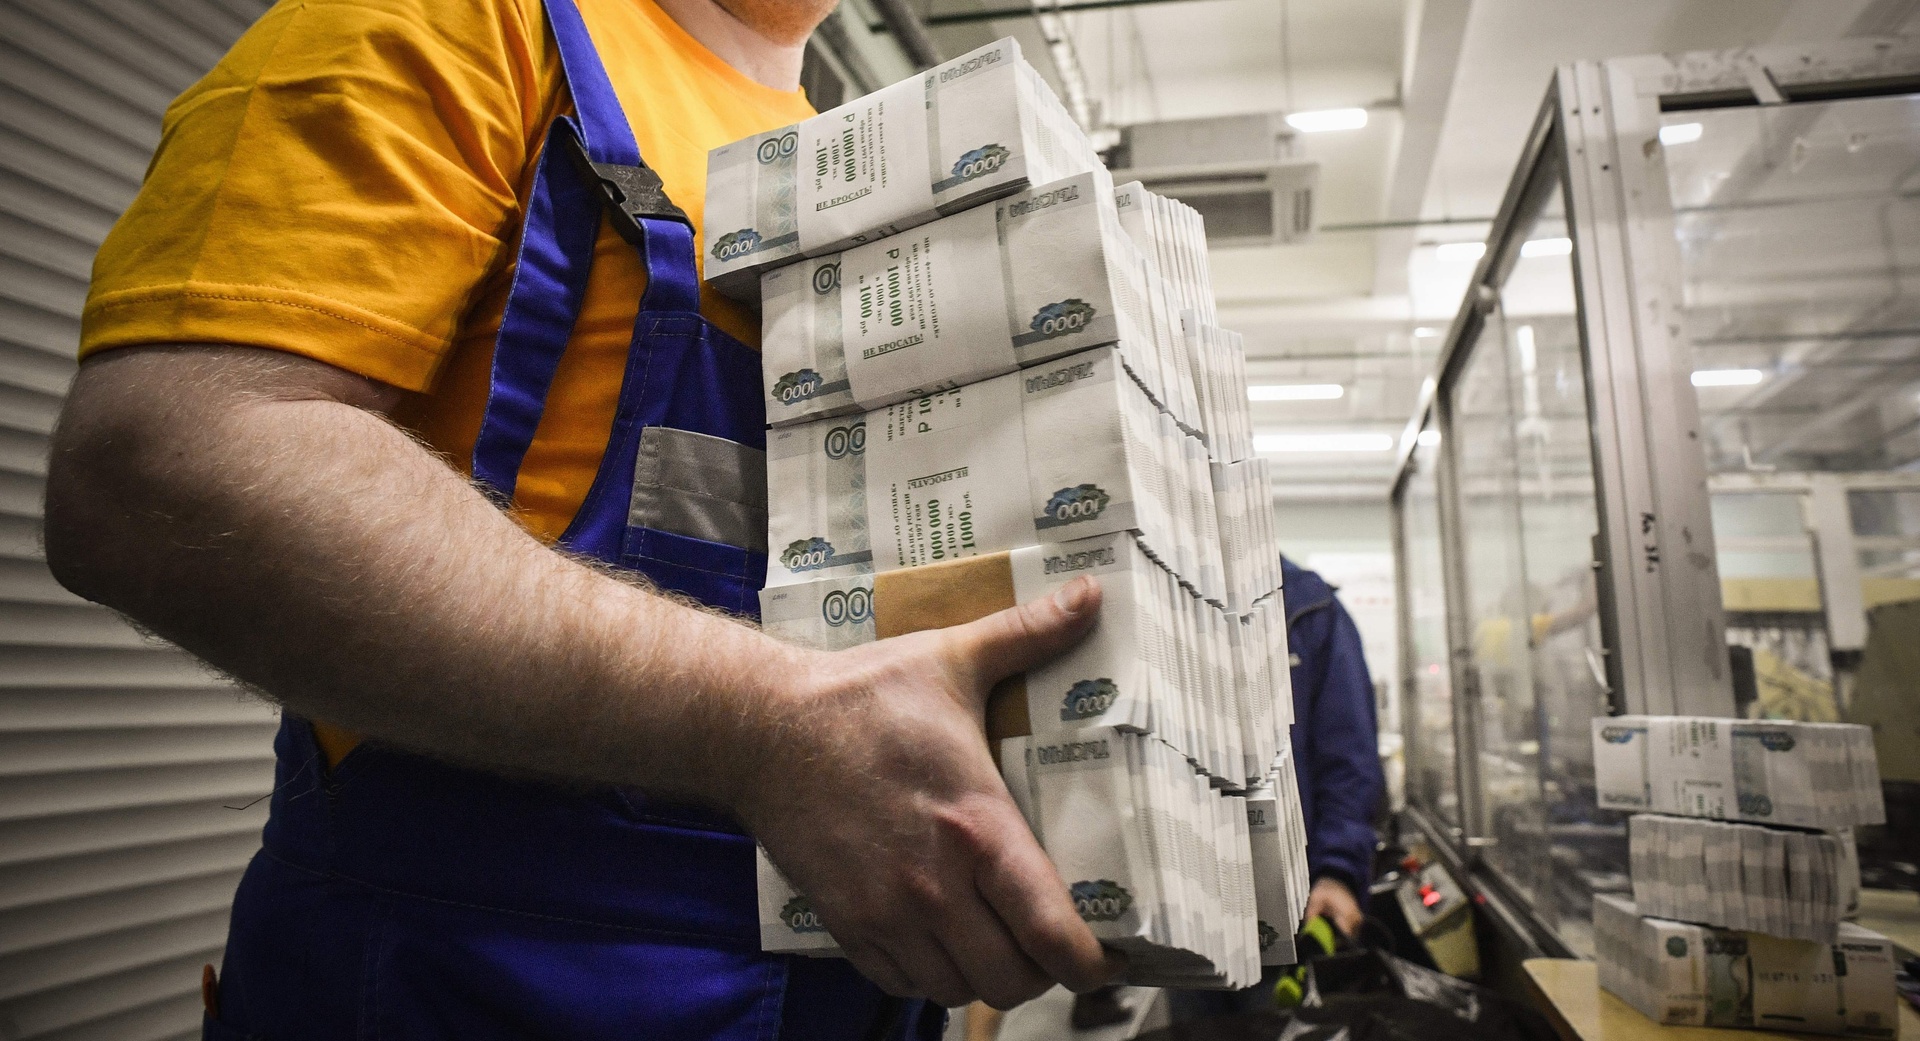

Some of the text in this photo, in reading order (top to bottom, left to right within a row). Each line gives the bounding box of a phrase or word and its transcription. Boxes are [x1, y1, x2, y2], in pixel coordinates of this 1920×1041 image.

[816, 147, 828, 176] 1000
[832, 144, 840, 166] 1000
[961, 154, 1001, 178] 1000
[816, 185, 872, 212] НЕ БРОСАТЬ!
[720, 238, 754, 259] 1000
[859, 275, 873, 336] по 1000 руб.
[876, 283, 884, 306] 1000
[917, 299, 925, 330] РОССИИ
[1042, 311, 1085, 335] 1000
[863, 333, 923, 359] НЕ БРОСАТЬ!
[782, 380, 815, 401] 1000
[908, 467, 968, 490] НЕ БРОСАТЬ!
[904, 493, 912, 525] РОССИИ
[958, 491, 976, 550] 1000 руб.
[1056, 498, 1099, 521] 1000
[894, 525, 901, 536] АО
[907, 527, 915, 554] БАНКА
[916, 523, 924, 541] 1997
[946, 523, 957, 549] 1000
[790, 549, 826, 569] 1000
